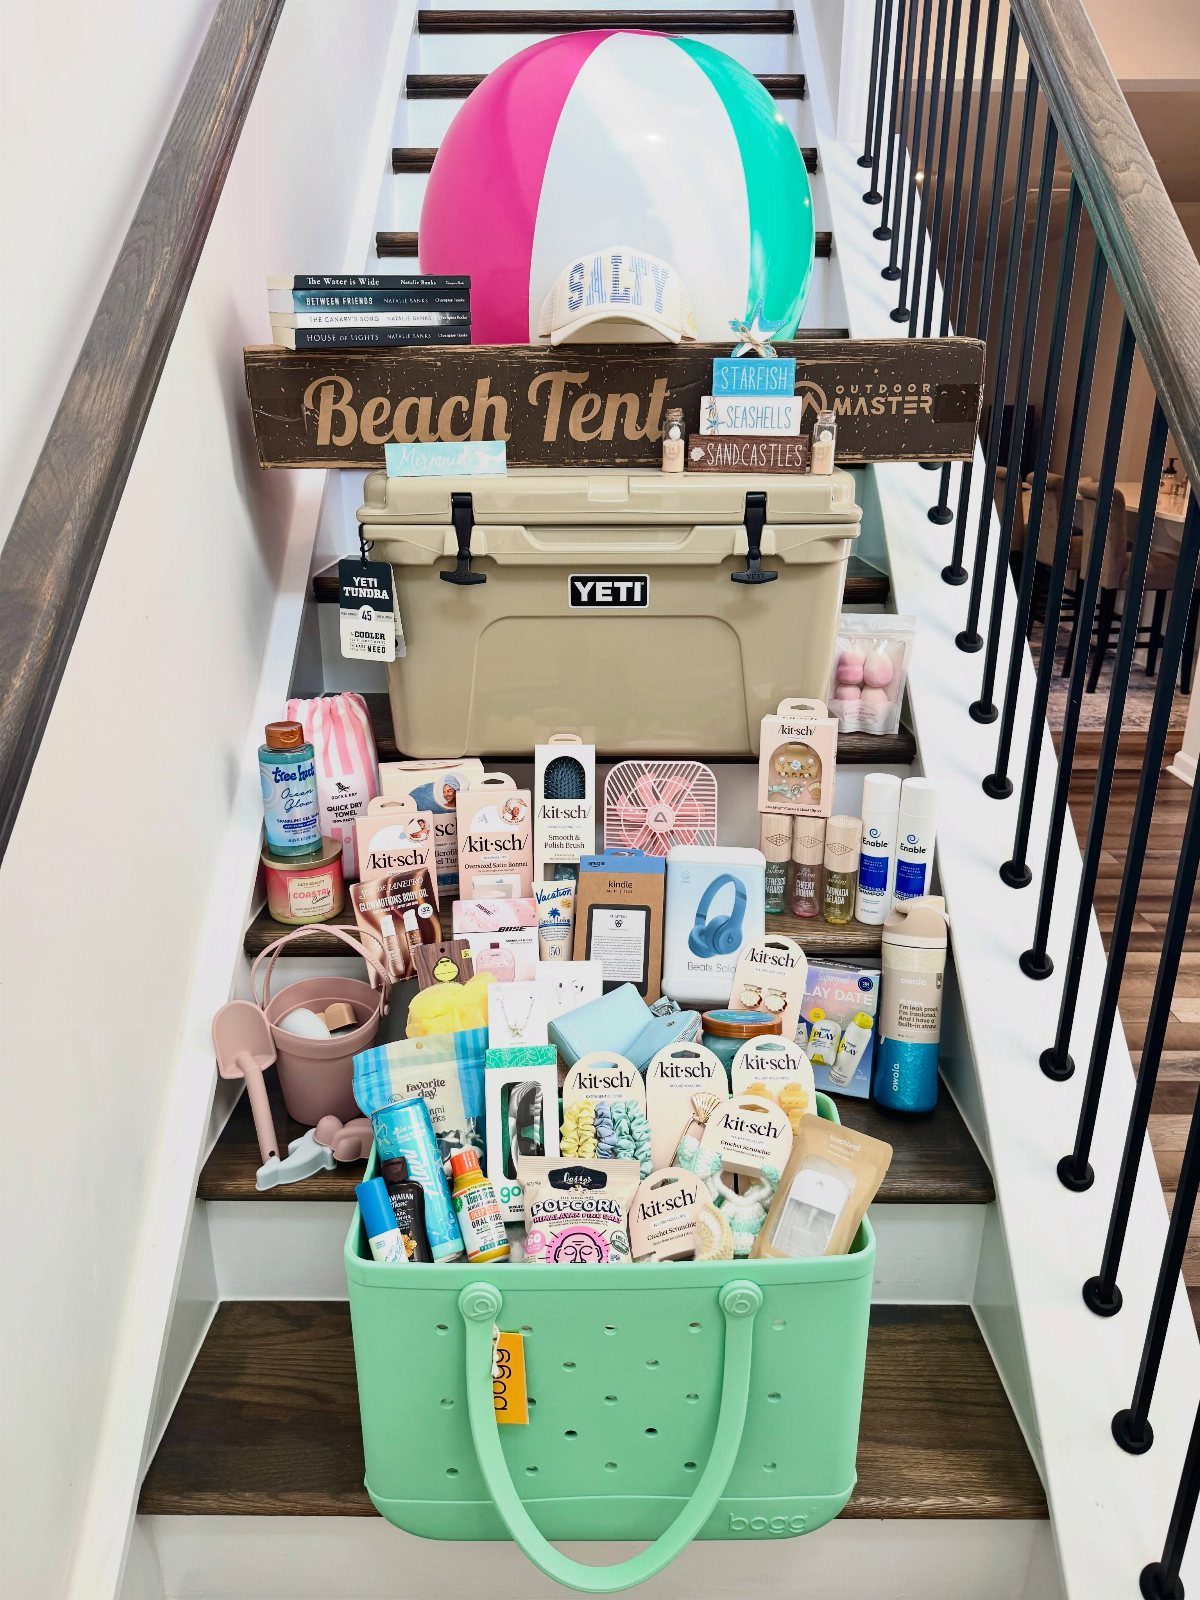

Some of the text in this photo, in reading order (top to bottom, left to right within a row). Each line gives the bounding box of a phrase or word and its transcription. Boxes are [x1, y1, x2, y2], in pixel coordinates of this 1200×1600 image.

[307, 277, 380, 286] The Water is Wide
[568, 255, 669, 313] SALTY
[306, 297, 373, 306] BETWEEN FRIENDS
[306, 334, 337, 342] HOUSE
[721, 366, 788, 391] STARFISH
[835, 383, 931, 395] OUTDOOR
[303, 370, 671, 446] Beach Tent
[832, 395, 933, 416] MASTER
[726, 405, 792, 430] SEASHELLS
[706, 442, 803, 467] SANDCASTLES
[353, 576, 379, 588] YETI
[343, 586, 390, 600] TUNDRA
[574, 581, 642, 602] YETI
[361, 610, 372, 621] 45
[354, 631, 386, 640] COOLER
[367, 645, 386, 654] NEED
[272, 762, 316, 783] tree hut
[281, 787, 314, 799] Ocean
[326, 801, 363, 812] QUICK DRY
[334, 810, 358, 818] TOWEL
[862, 836, 888, 848] Enable
[899, 842, 927, 854] Enable
[386, 877, 424, 893] JANEIRO
[608, 880, 633, 889] kindle
[402, 890, 418, 901] BODY
[419, 887, 429, 899] OIL
[535, 887, 572, 904] Vacation
[550, 946, 561, 957] 50
[687, 961, 713, 972] Beats
[900, 978, 927, 986] owala
[834, 989, 874, 1006] DATE
[897, 1020, 920, 1029] built-in
[812, 1030, 835, 1041] PLAY
[892, 1061, 900, 1092] owala
[406, 1078, 446, 1093] favorite
[417, 1087, 437, 1099] day
[500, 1185, 522, 1204] go
[531, 1199, 622, 1217] POPCORN
[471, 1217, 489, 1229] ORAL
[728, 1512, 808, 1535] bogg
